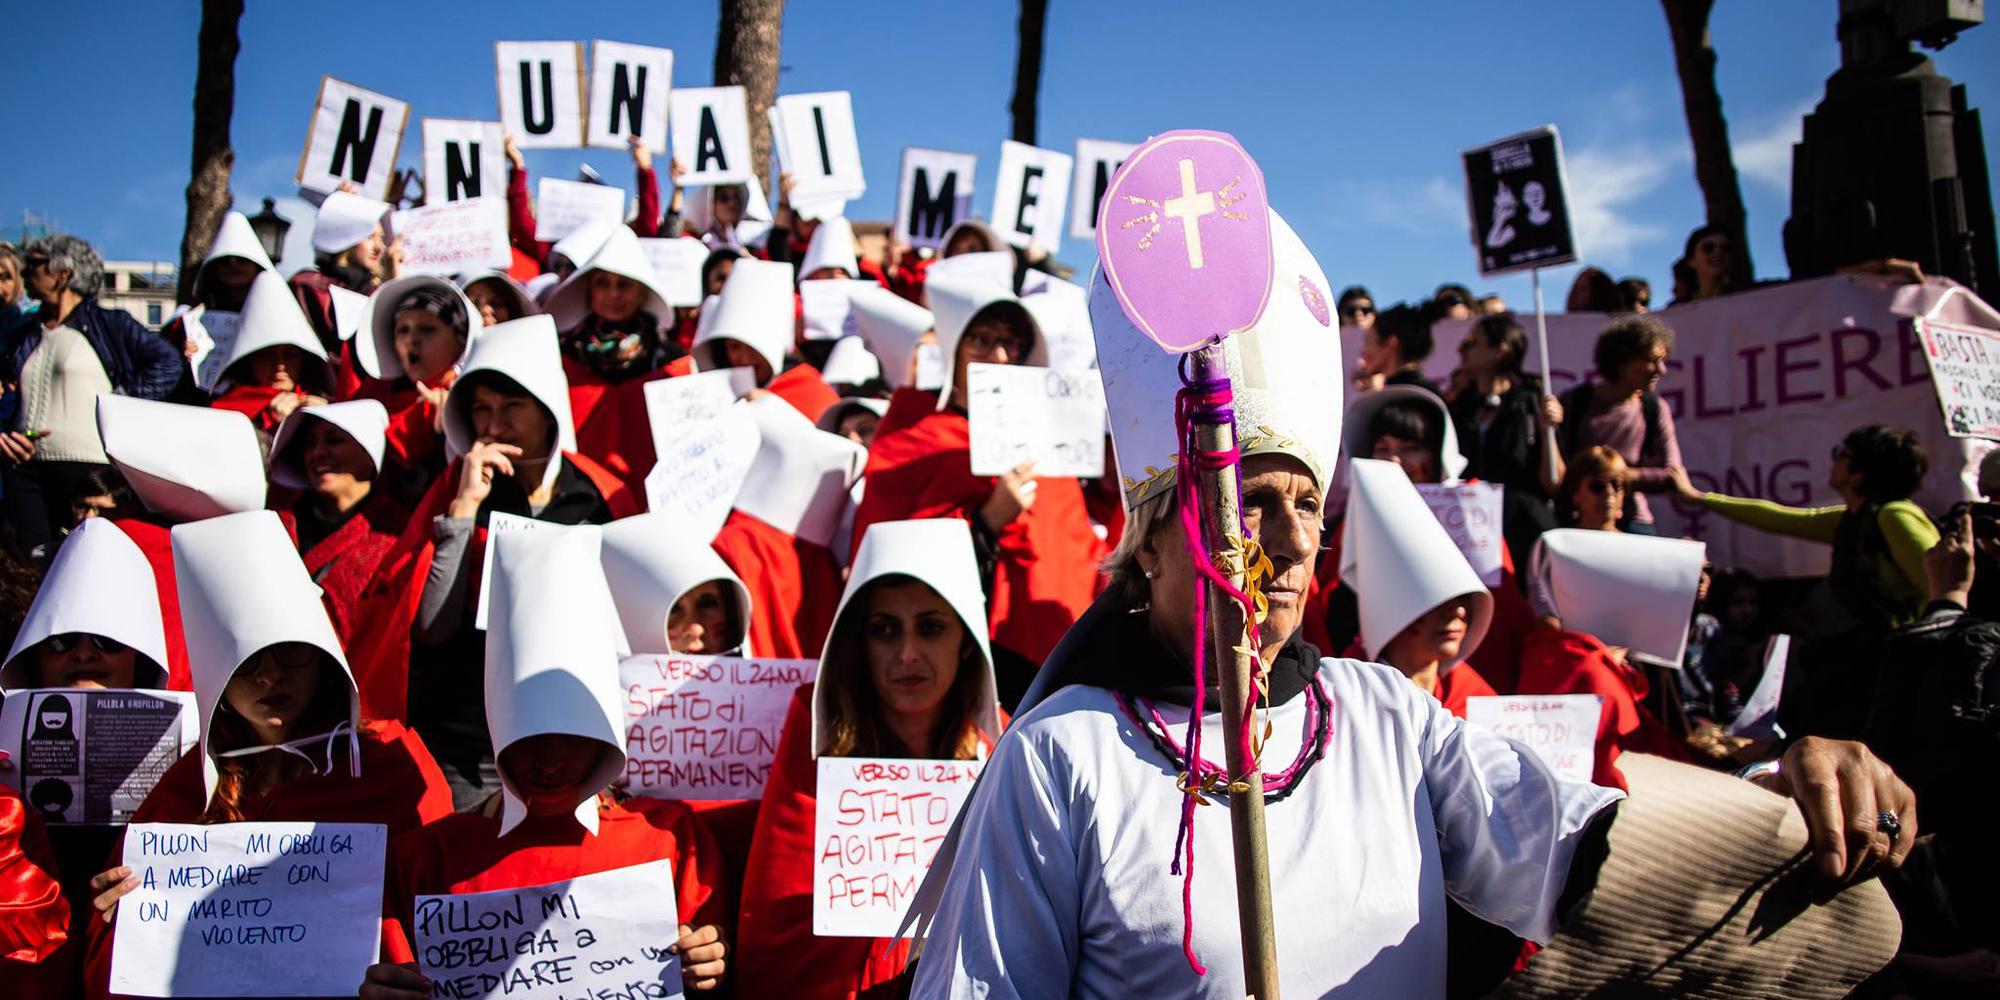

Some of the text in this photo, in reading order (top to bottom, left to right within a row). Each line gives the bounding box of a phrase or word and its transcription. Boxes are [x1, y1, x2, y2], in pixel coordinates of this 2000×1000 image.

[520, 61, 555, 135] U
[609, 62, 648, 138] N
[329, 97, 384, 185] N
[696, 105, 728, 172] A
[812, 105, 833, 176] I
[445, 140, 481, 202] N
[909, 166, 957, 239] M
[1014, 165, 1045, 236] E
[1935, 332, 1990, 366] BASTA
[655, 659, 724, 683] VERSO
[731, 664, 749, 684] IL
[97, 699, 124, 709] PILLOLA
[628, 684, 711, 721] STATO
[626, 724, 783, 759] AGITAZION
[852, 763, 910, 783] VERSO
[916, 766, 934, 783] IL
[836, 789, 949, 826] STATO
[141, 830, 209, 856] PILLON
[245, 834, 272, 856] MI
[142, 861, 331, 890] A MEDIARE CON
[828, 873, 916, 912] PERM
[139, 897, 273, 922] UN MARITO
[416, 893, 581, 937] PILLON MI
[201, 924, 307, 946] VIOLENTO
[425, 929, 559, 969] OBBLIGA
[431, 955, 577, 1000] MEDIARE
[588, 956, 634, 975] con
